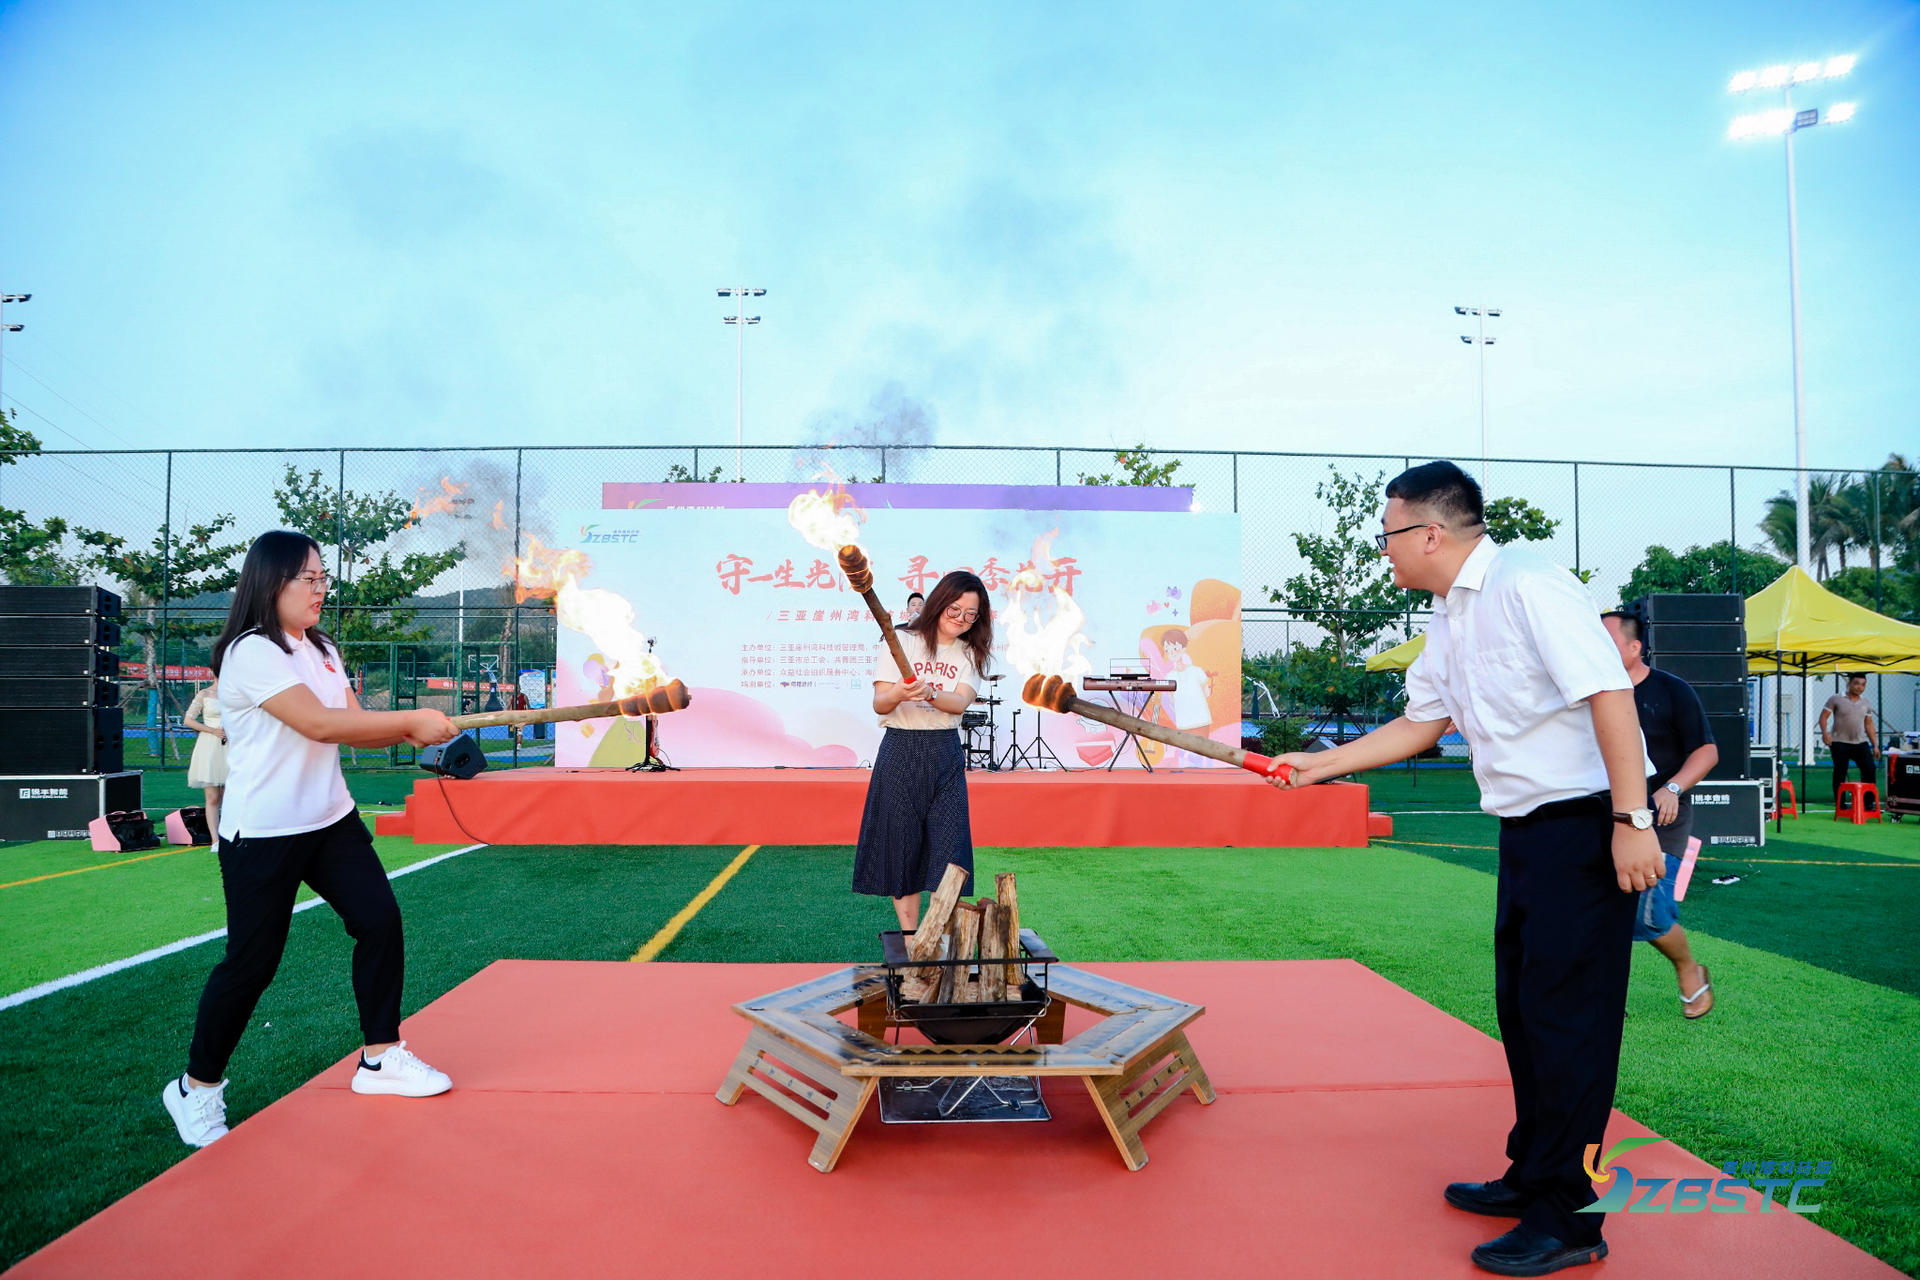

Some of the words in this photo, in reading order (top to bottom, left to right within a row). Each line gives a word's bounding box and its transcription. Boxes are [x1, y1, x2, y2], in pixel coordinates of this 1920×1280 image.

[716, 553, 874, 596] 守一生光
[898, 554, 1082, 597] 寻季花开
[914, 661, 958, 679] PARIS
